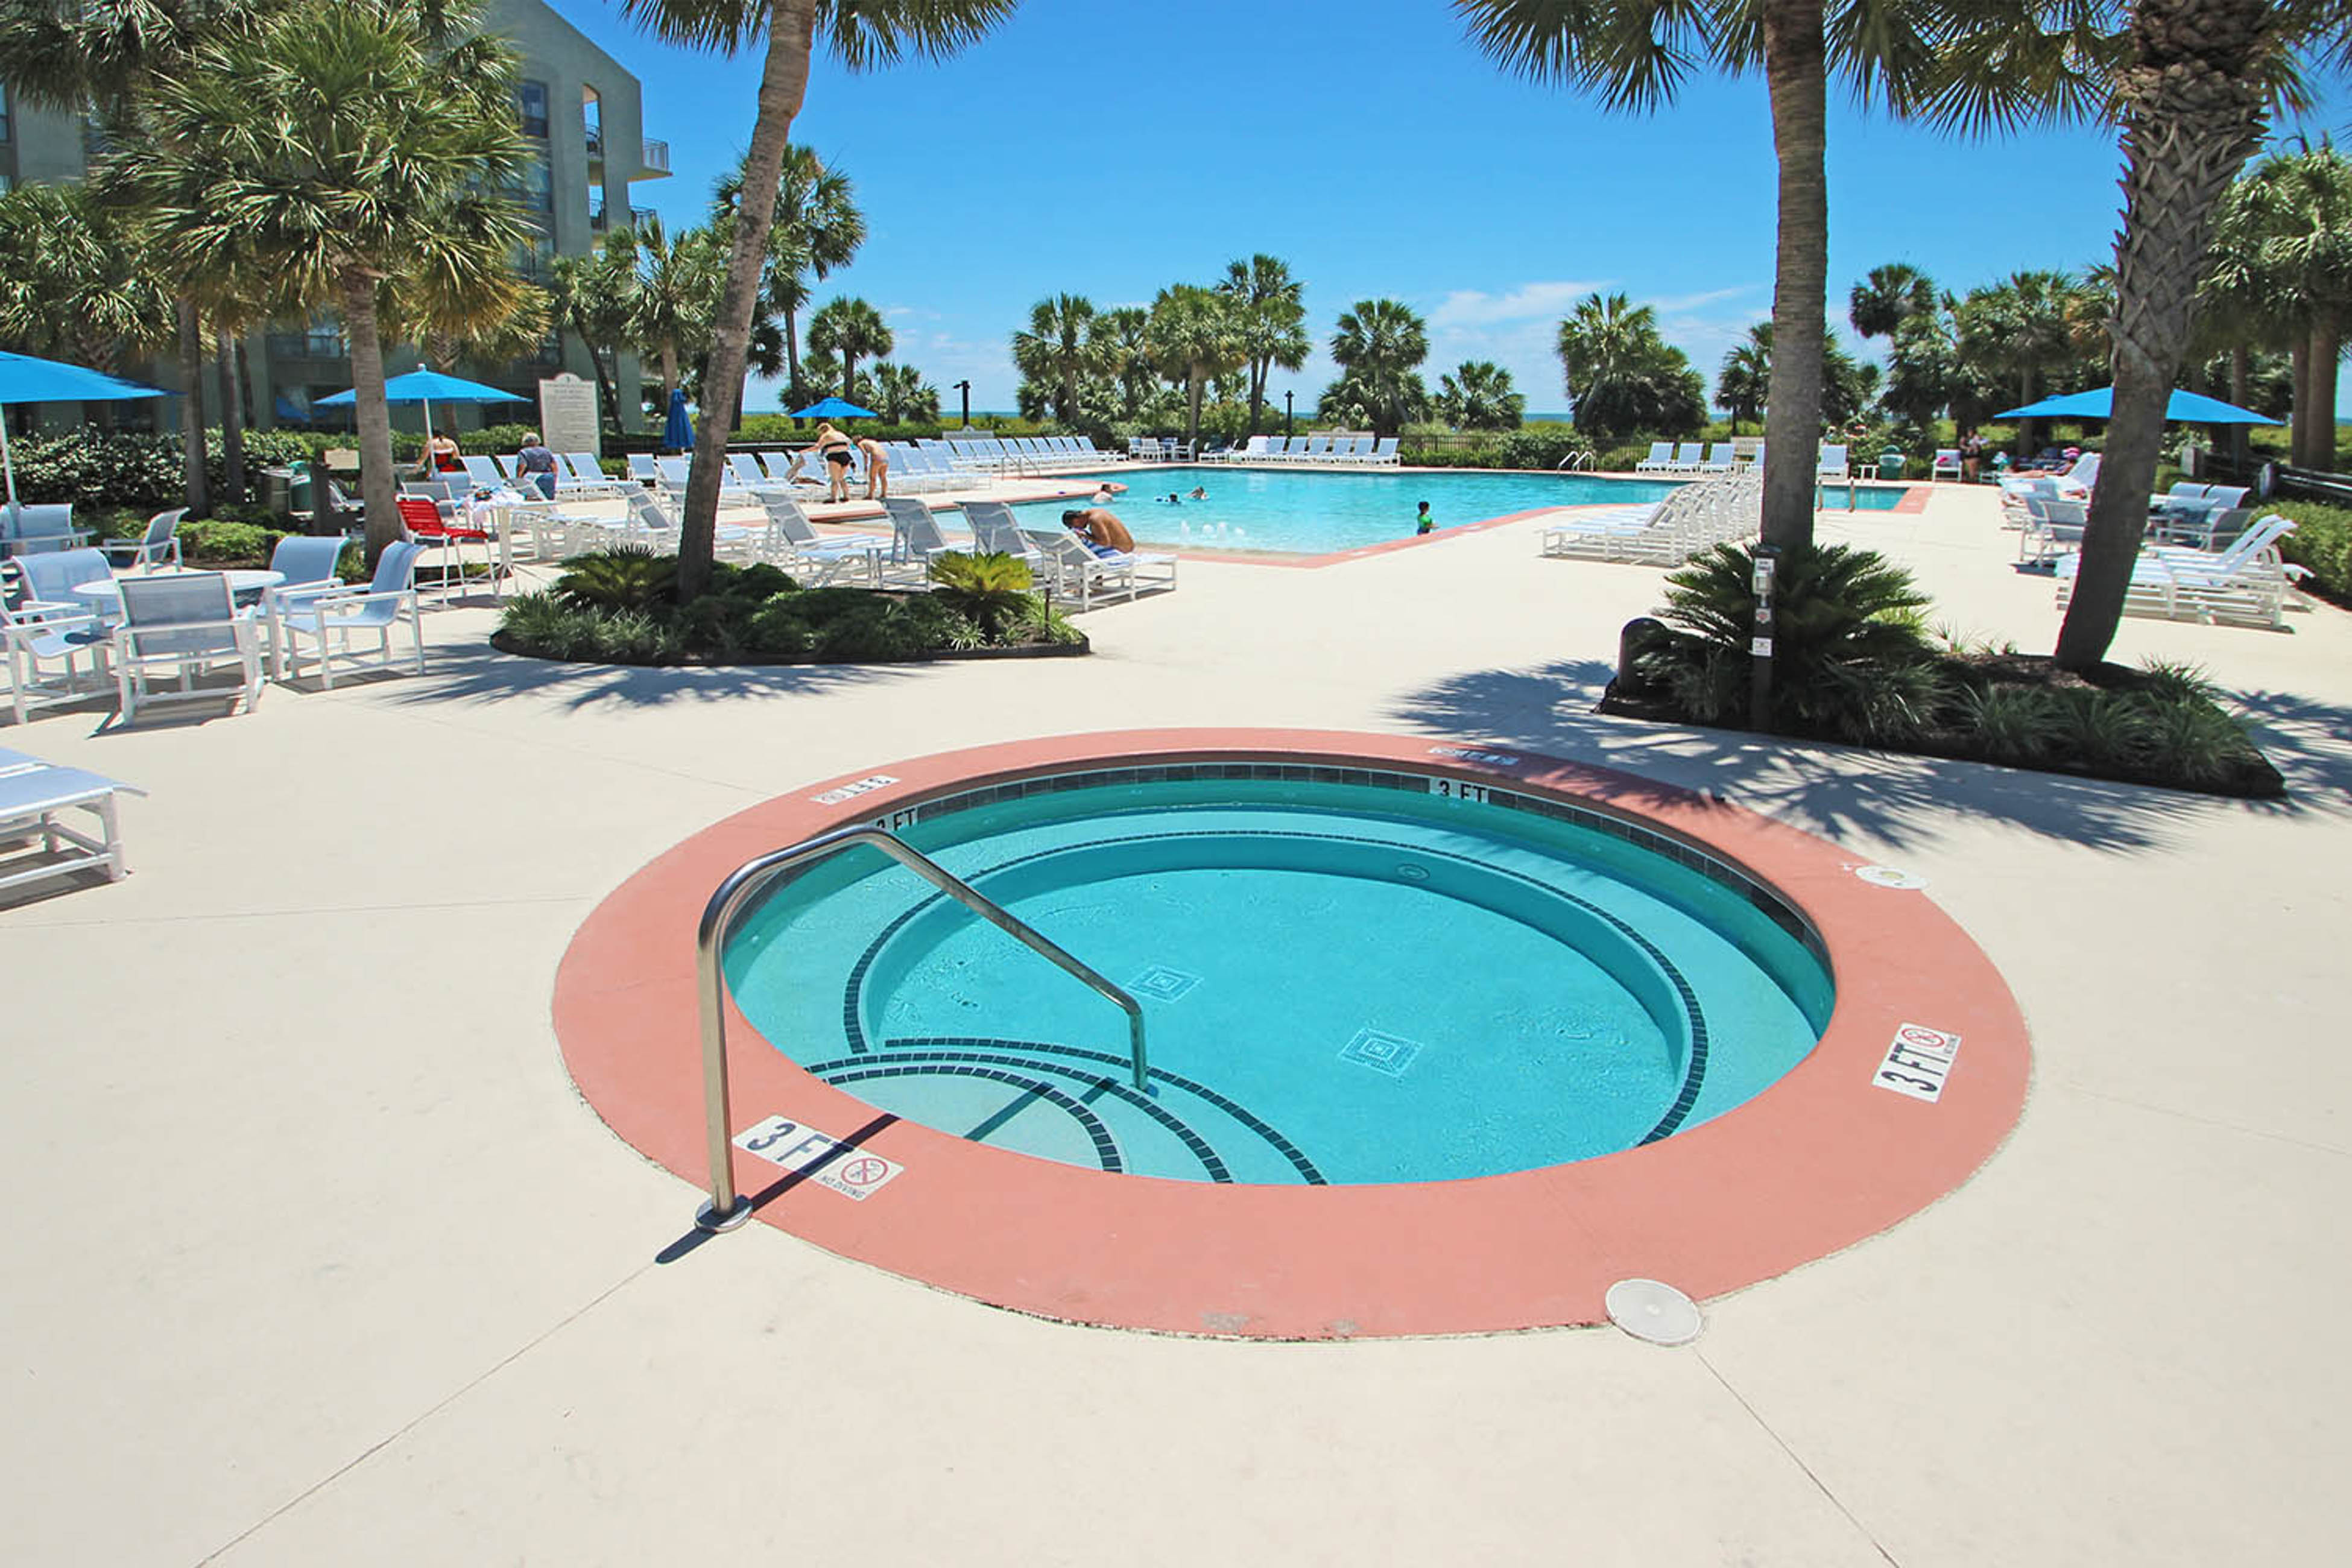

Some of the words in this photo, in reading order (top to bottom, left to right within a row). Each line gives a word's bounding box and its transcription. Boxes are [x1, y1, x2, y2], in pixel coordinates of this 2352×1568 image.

[1439, 780, 1450, 797] 3
[1460, 783, 1487, 803] FT
[894, 808, 915, 831] FT
[1888, 1042, 1949, 1076] FT
[1881, 1071, 1938, 1092] 3
[747, 1122, 797, 1150] 3
